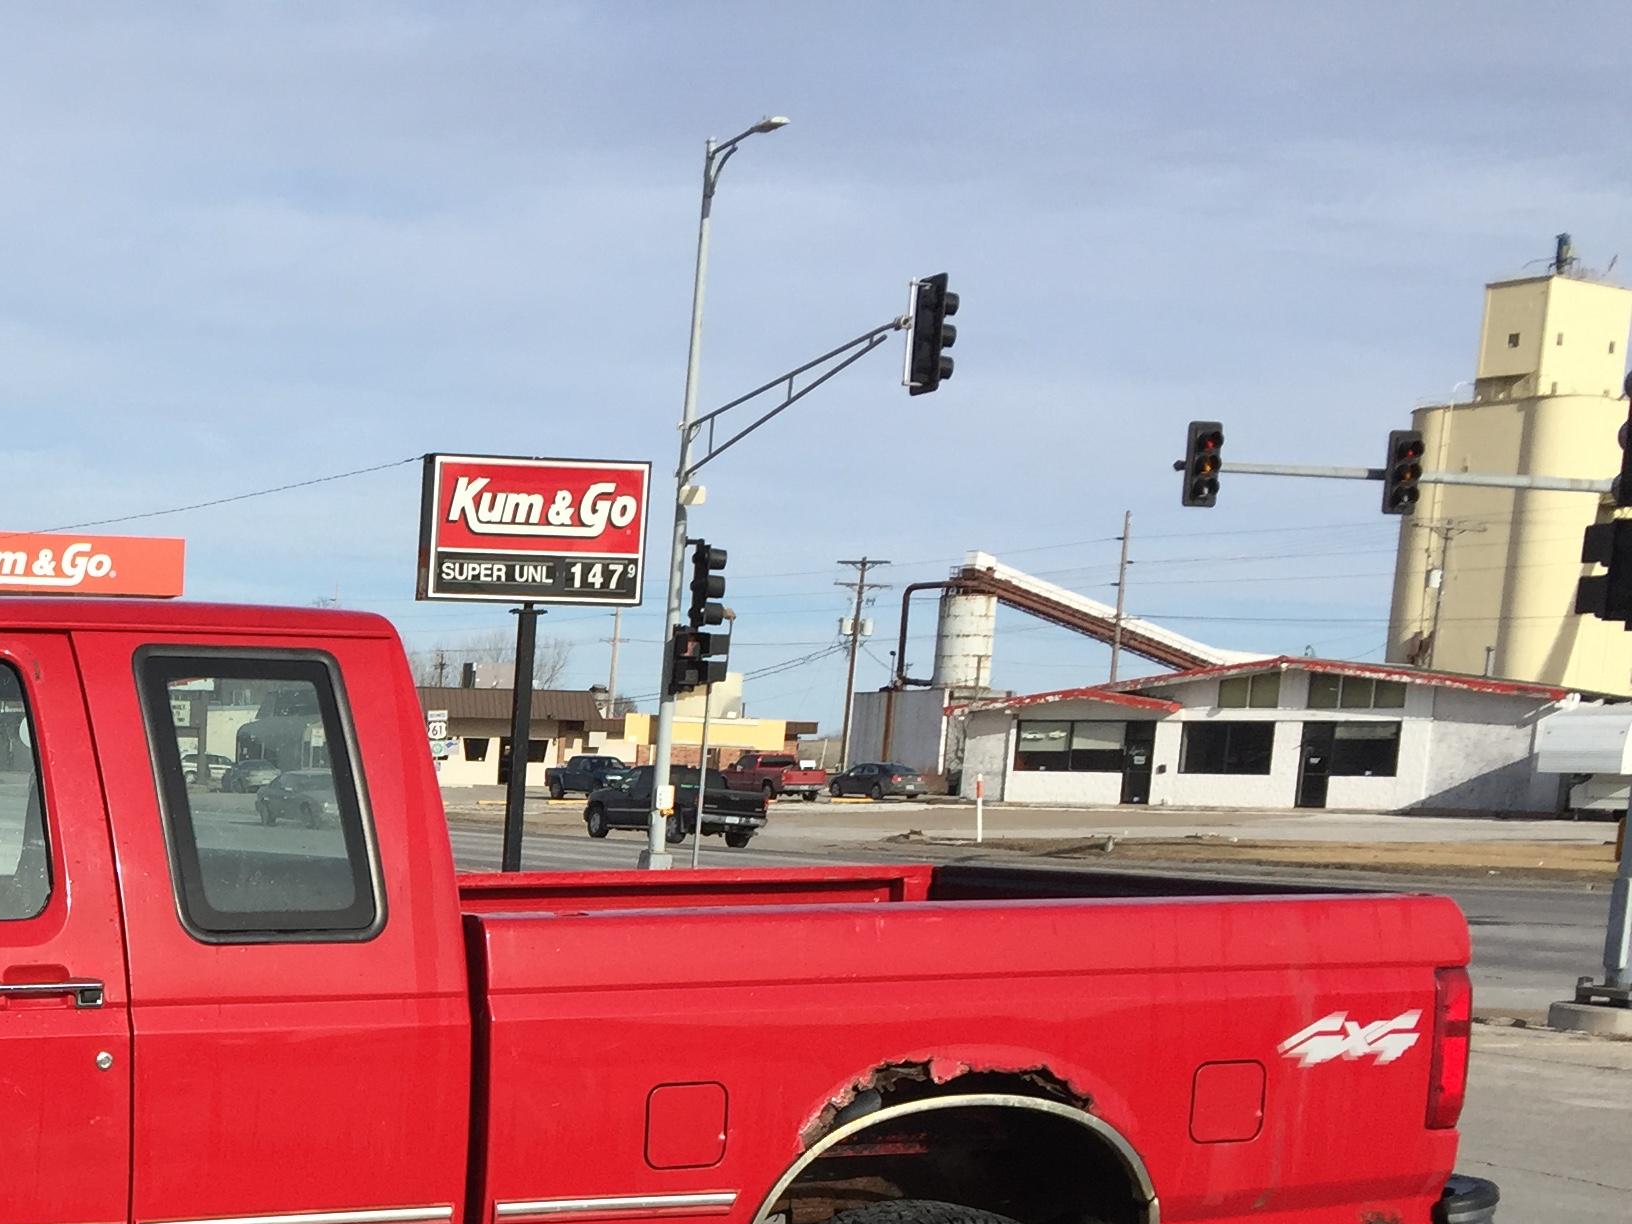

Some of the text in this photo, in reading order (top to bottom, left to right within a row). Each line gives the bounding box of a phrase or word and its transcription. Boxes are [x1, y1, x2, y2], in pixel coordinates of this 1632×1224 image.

[448, 477, 637, 537] Kum & Go
[32, 548, 56, 576] &
[61, 542, 112, 586] Go
[441, 562, 506, 581] SUPER
[514, 565, 554, 583] UNL
[431, 725, 443, 736] 61
